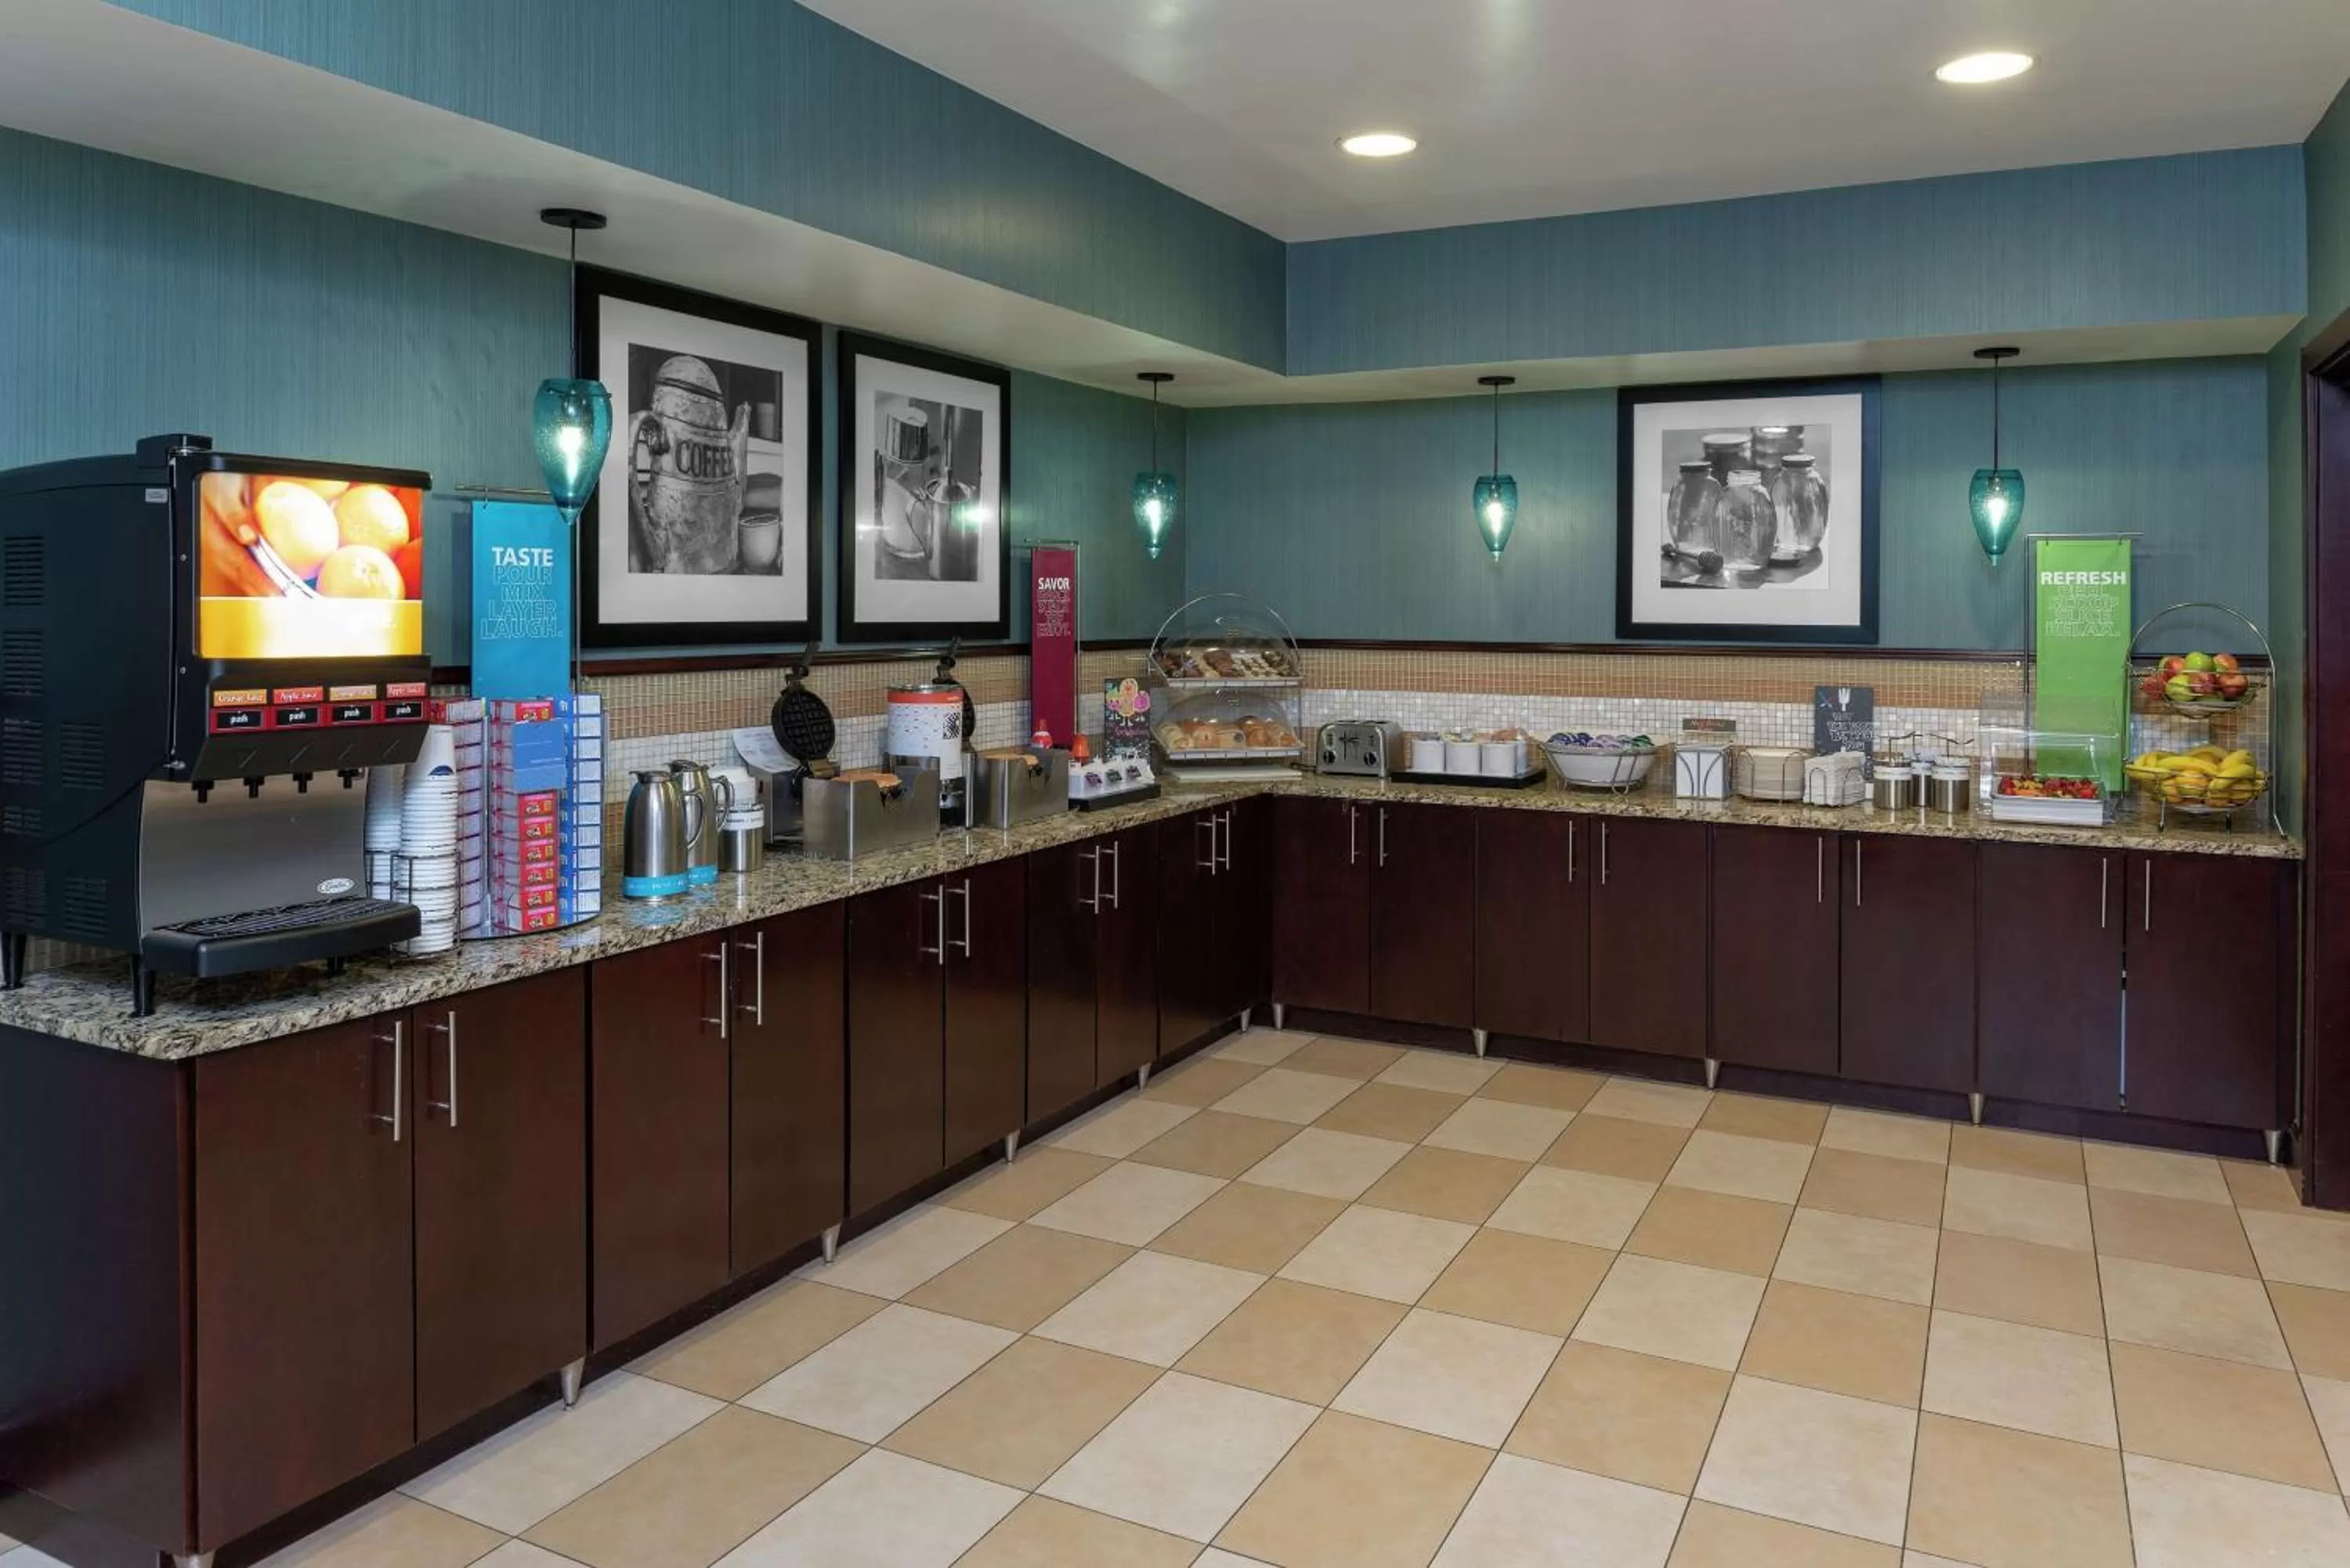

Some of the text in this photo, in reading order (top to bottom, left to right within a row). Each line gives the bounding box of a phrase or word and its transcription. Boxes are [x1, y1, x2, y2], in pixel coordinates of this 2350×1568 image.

[491, 547, 553, 566] TASTE
[494, 565, 552, 585] POUR
[2041, 571, 2127, 586] REFRESH
[1038, 577, 1070, 591] SAVOR
[501, 583, 544, 602] MIX
[488, 600, 557, 620] LAYER
[480, 617, 564, 639] LAUGH.
[288, 710, 307, 722] push
[344, 707, 360, 719] push
[396, 705, 411, 716] push
[230, 714, 249, 725] push
